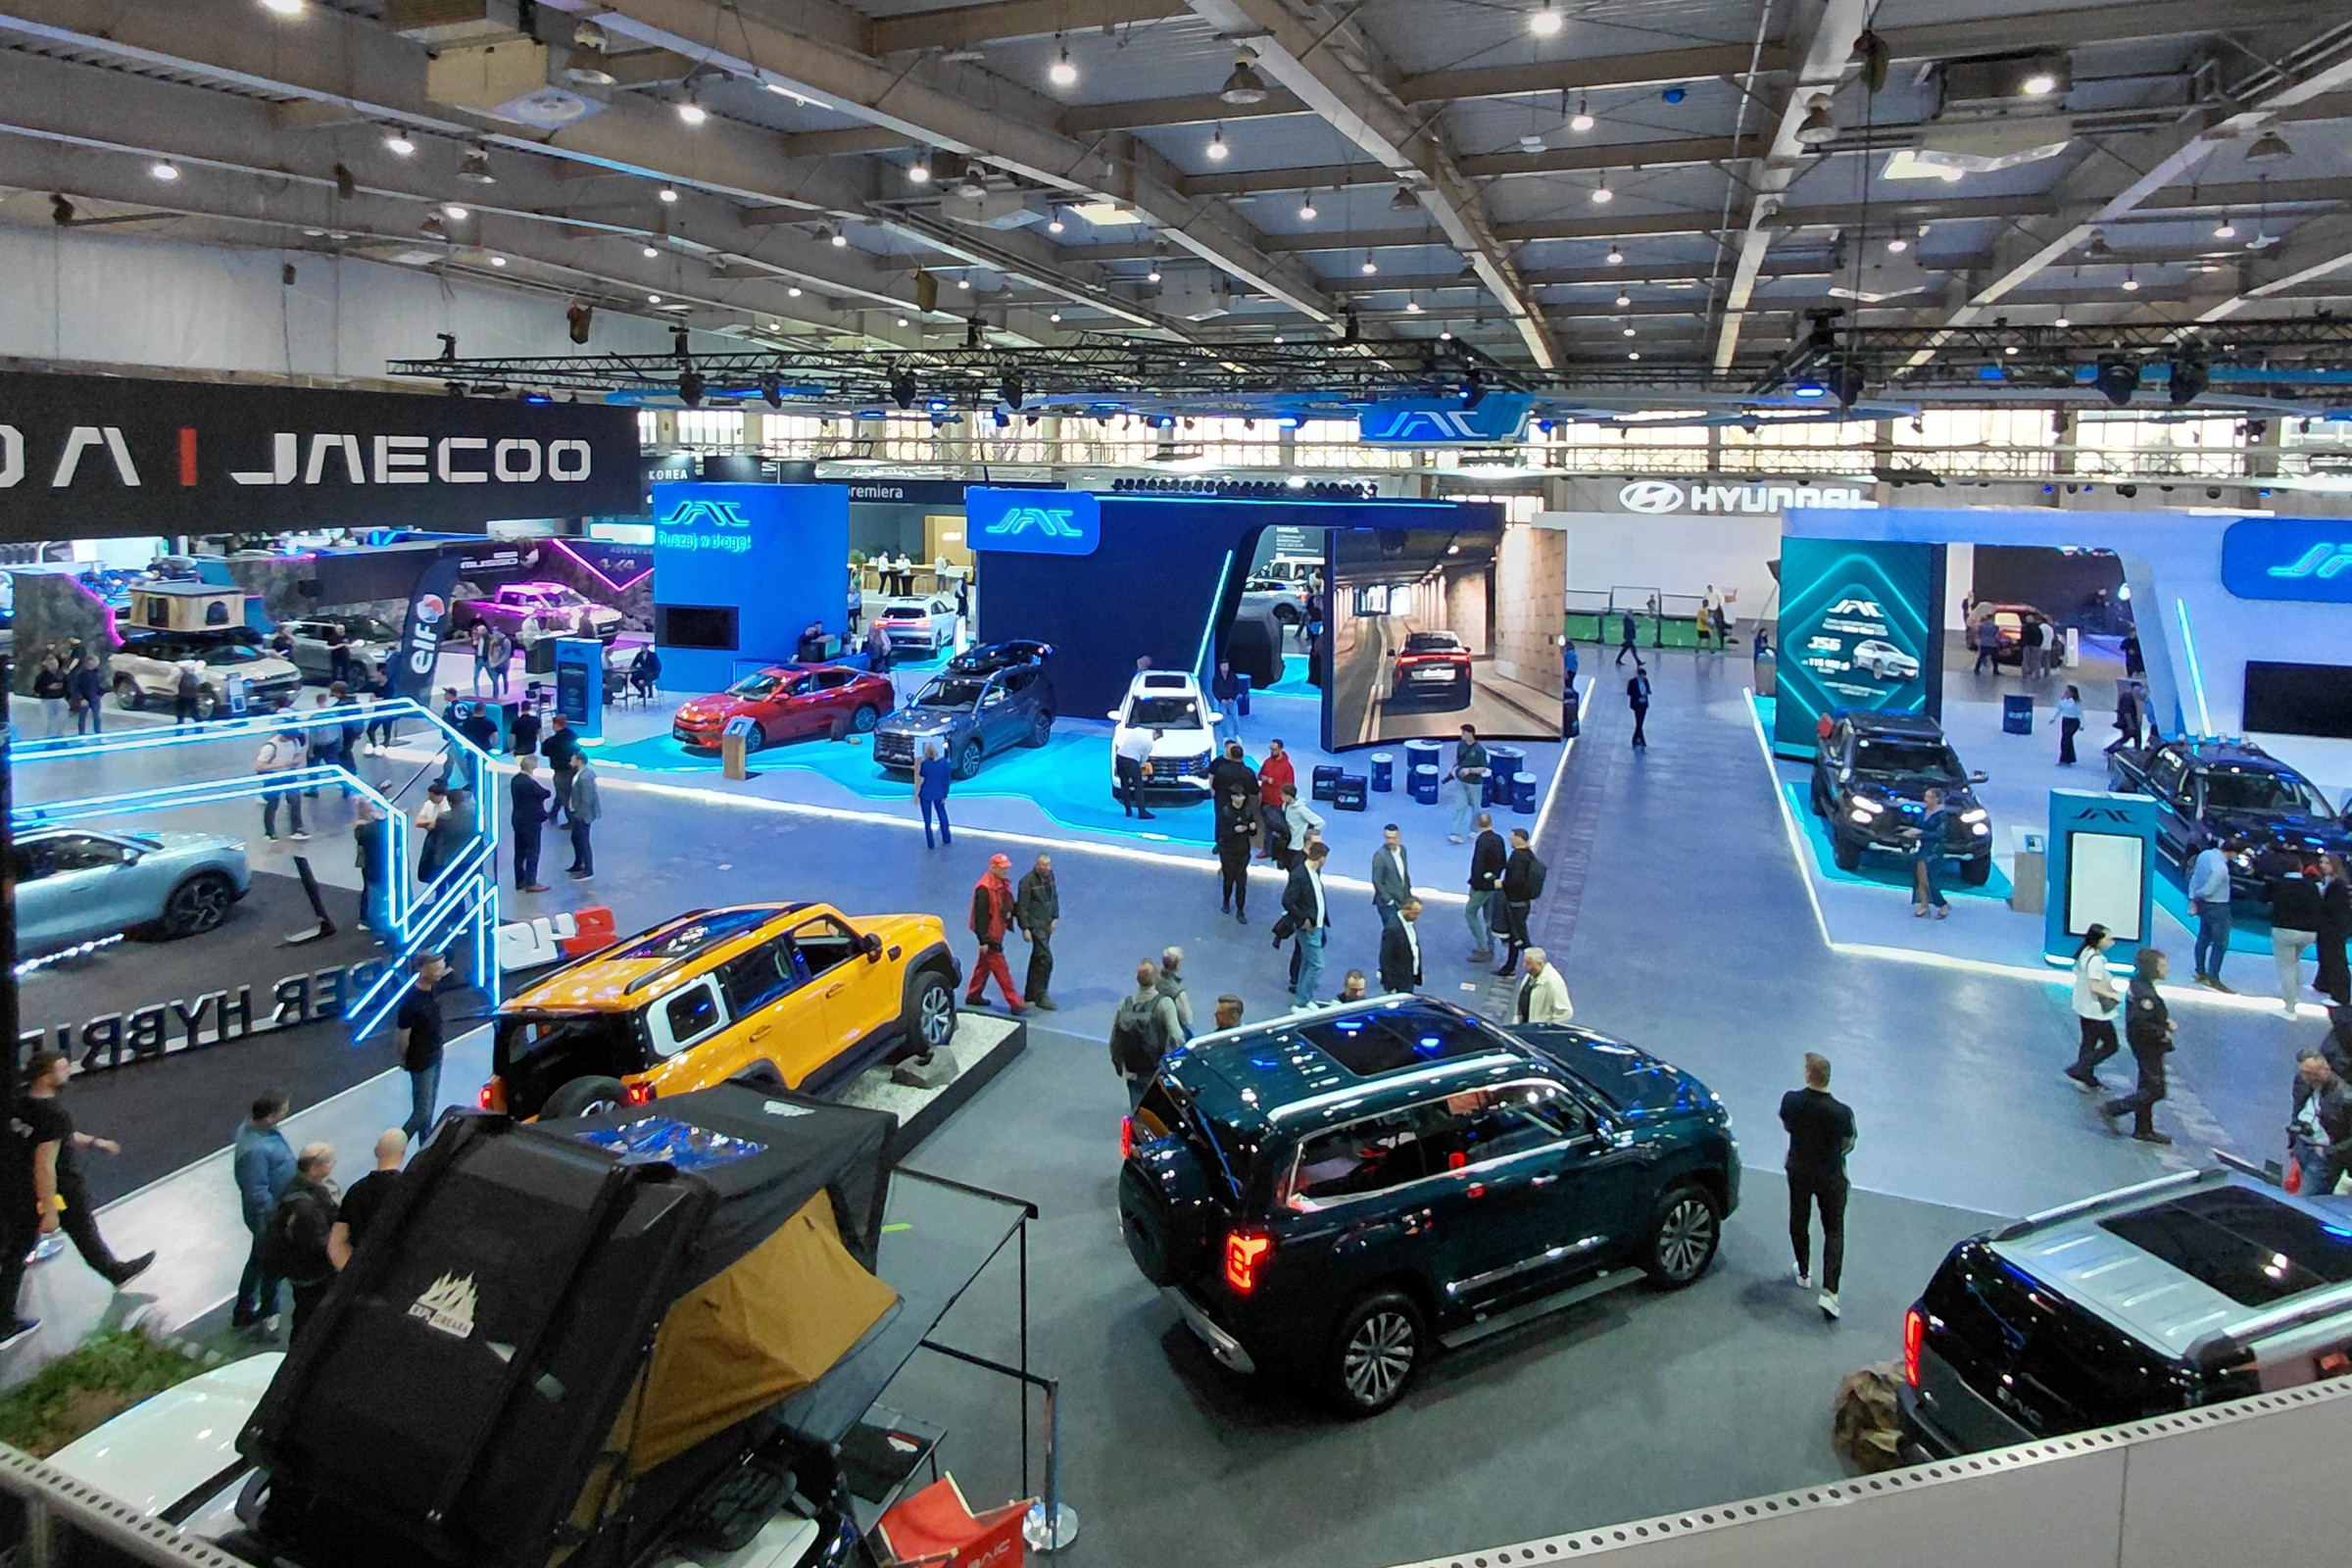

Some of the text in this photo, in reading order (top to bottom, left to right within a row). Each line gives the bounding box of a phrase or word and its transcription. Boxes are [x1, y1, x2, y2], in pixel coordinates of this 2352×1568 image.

[1375, 411, 1489, 437] JAC
[229, 432, 592, 485] JAECOO
[648, 469, 688, 480] KOREA
[848, 483, 904, 499] remiera
[659, 500, 751, 527] JAC
[984, 508, 1084, 537] JAC
[1826, 599, 1886, 618] JAC
[410, 622, 438, 675] elf
